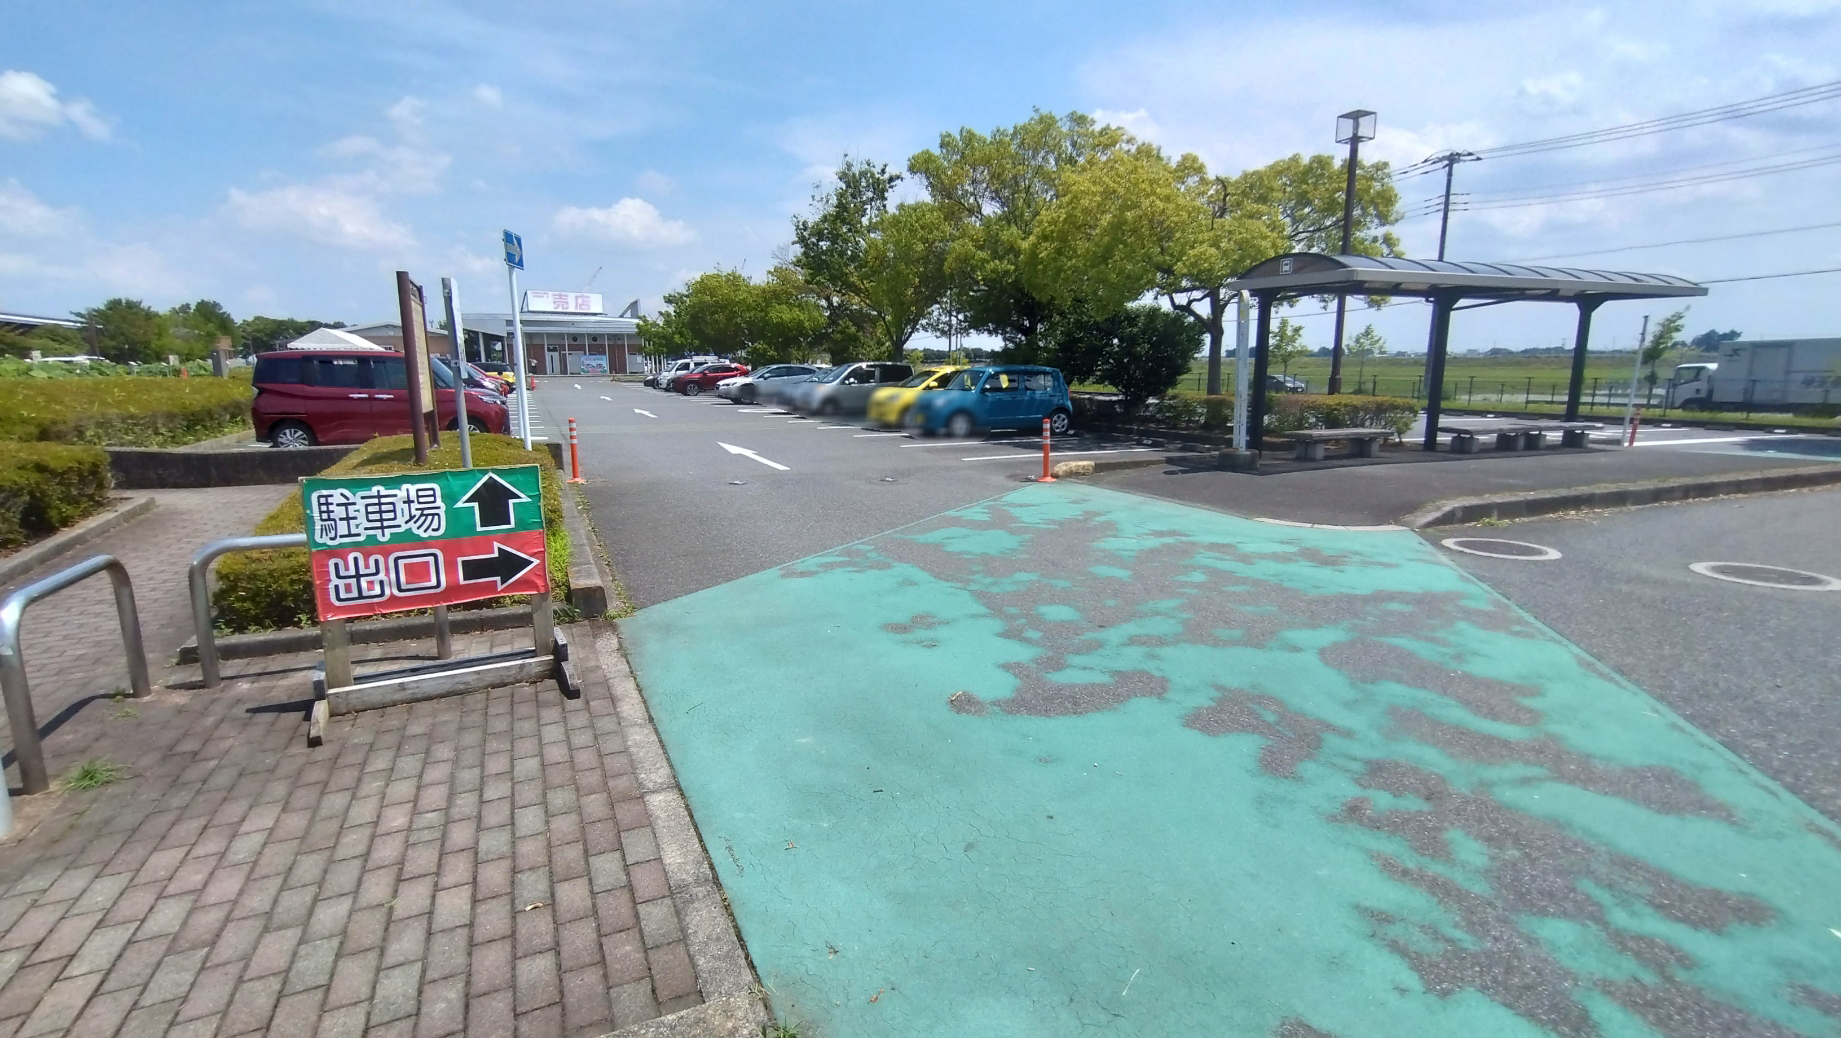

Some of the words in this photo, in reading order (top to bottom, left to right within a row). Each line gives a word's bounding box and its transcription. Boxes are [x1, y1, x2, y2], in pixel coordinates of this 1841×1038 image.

[552, 293, 591, 311] 売店
[314, 485, 445, 544] 駐車場
[330, 551, 444, 605] 出口
